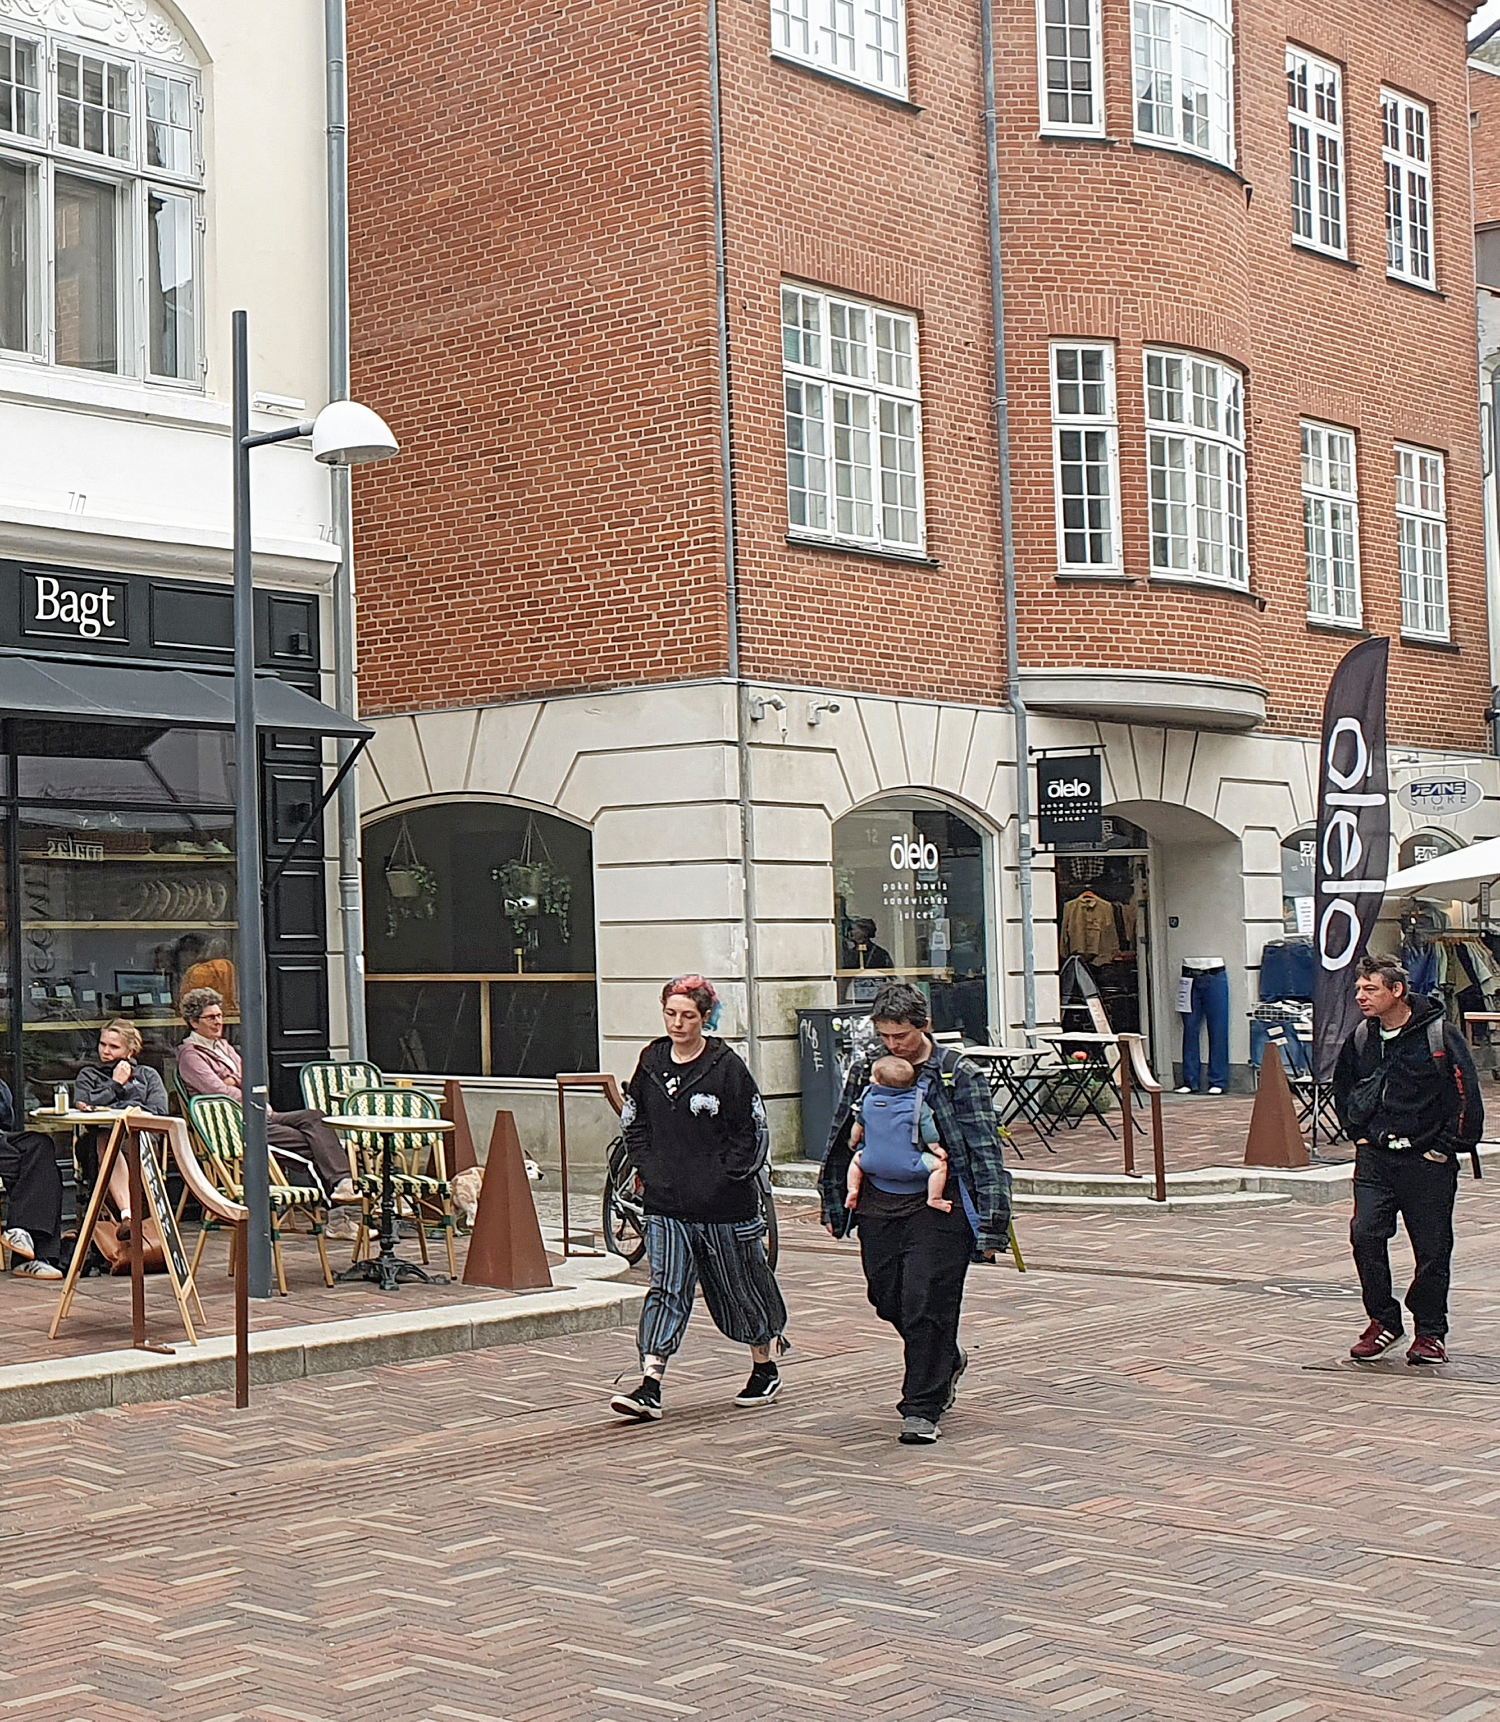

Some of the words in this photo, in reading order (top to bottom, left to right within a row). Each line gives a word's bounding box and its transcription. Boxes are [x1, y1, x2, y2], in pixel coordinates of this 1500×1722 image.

[34, 575, 116, 639] Bagt
[1047, 778, 1091, 798] ōlelo
[1411, 783, 1466, 796] JEANS
[1410, 795, 1467, 807] STORE
[890, 833, 938, 870] ōlelo
[882, 882, 910, 893] poke
[915, 881, 949, 891] bowls
[883, 896, 949, 905] sandwiches
[899, 911, 935, 921] juices
